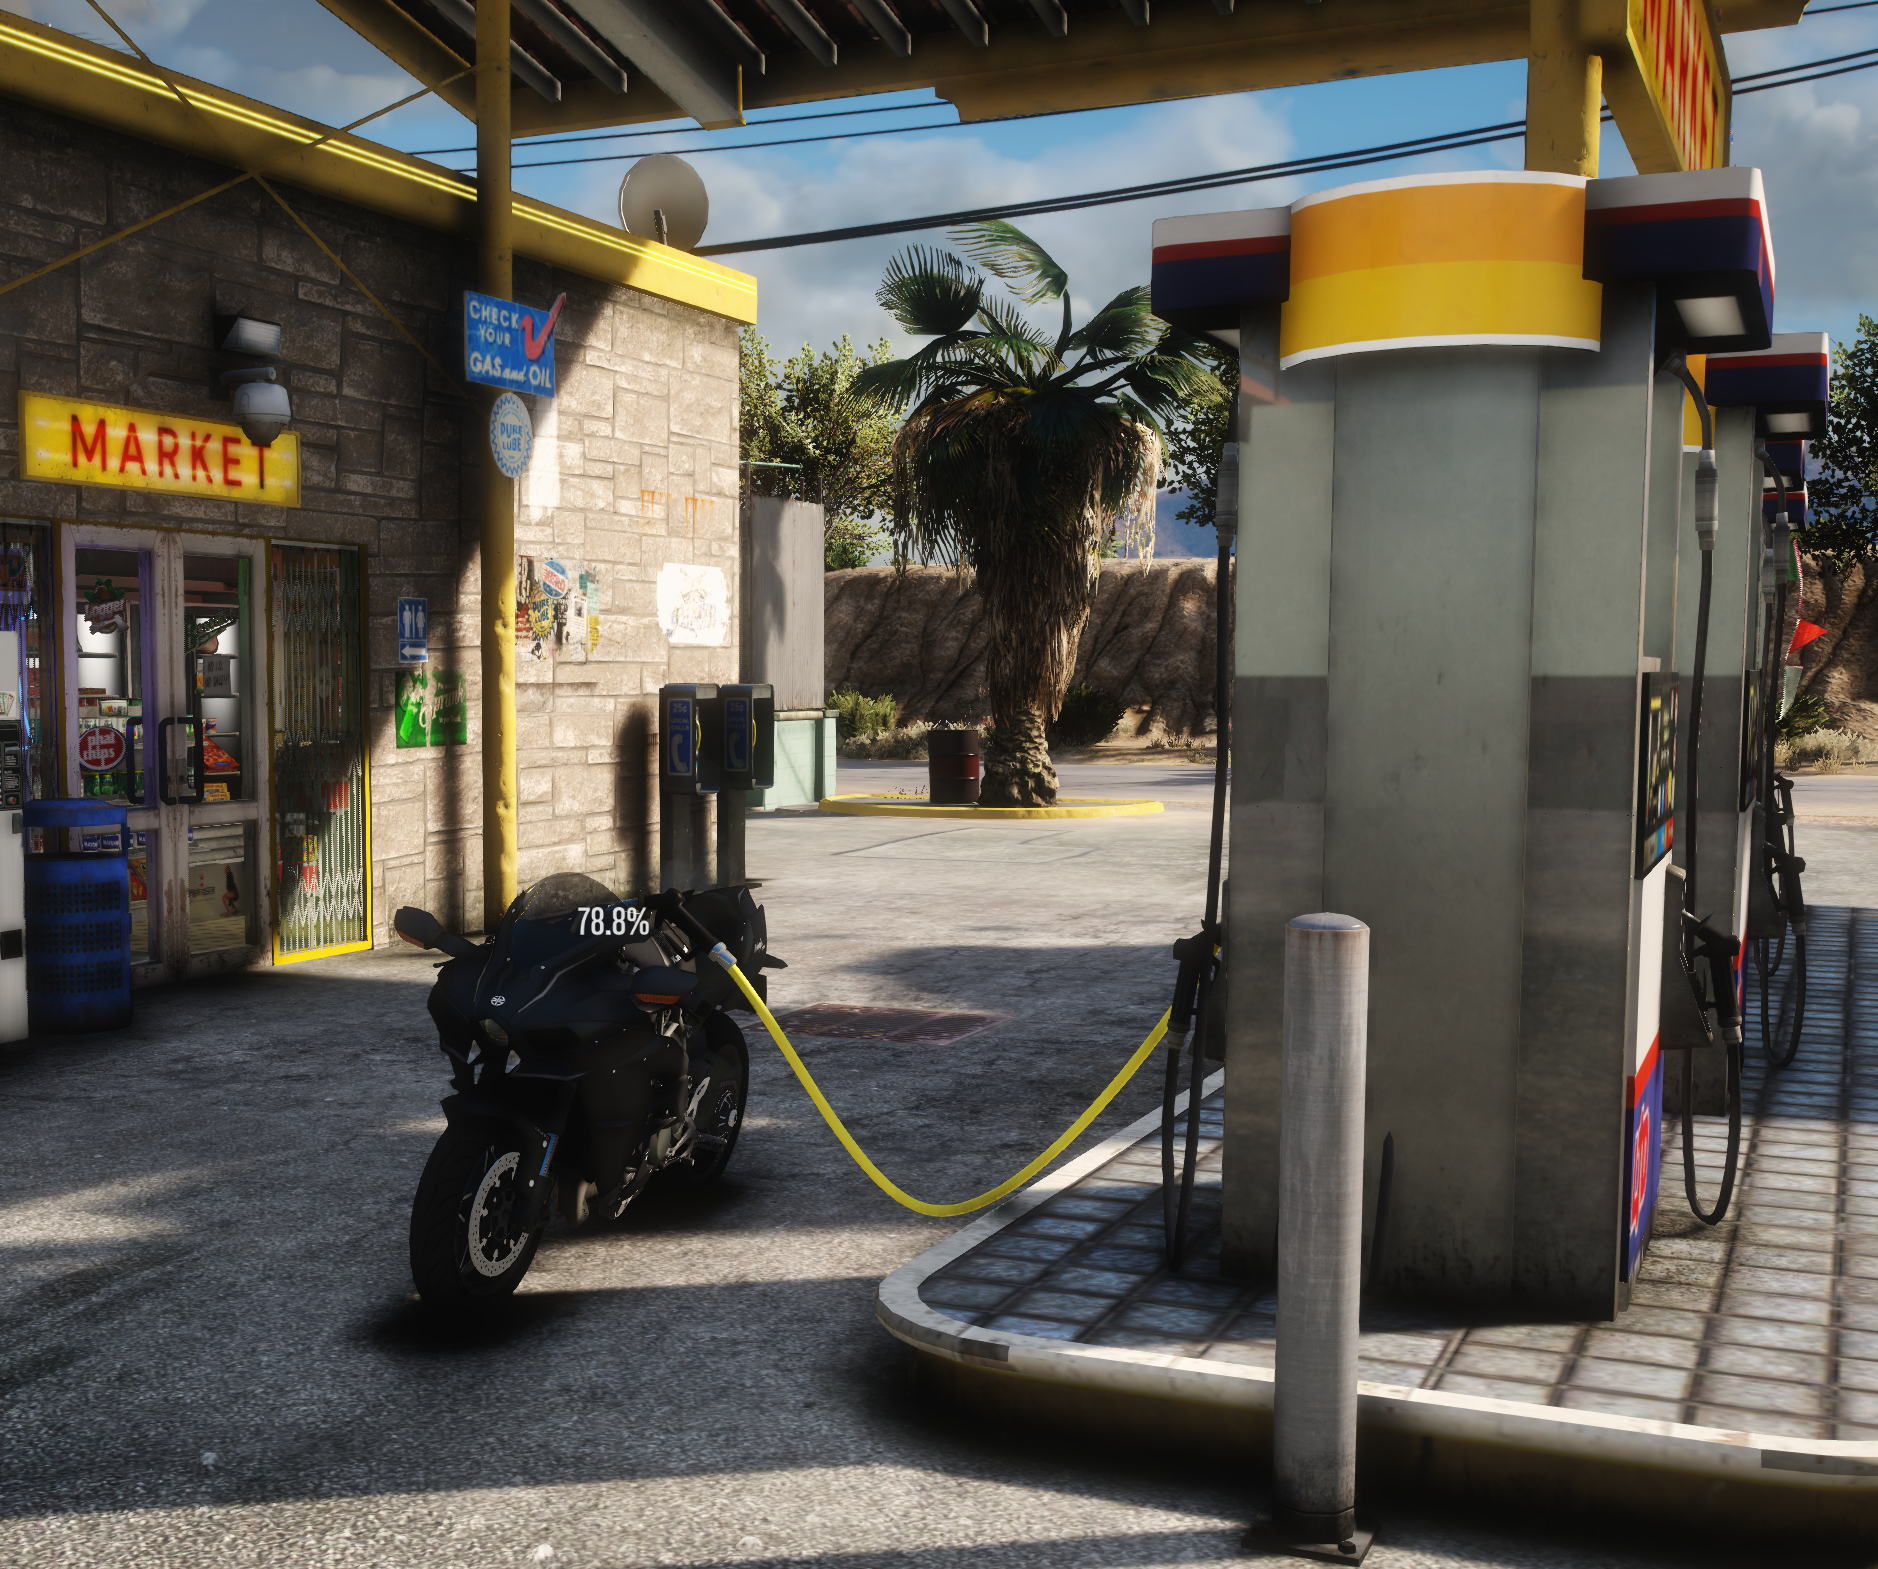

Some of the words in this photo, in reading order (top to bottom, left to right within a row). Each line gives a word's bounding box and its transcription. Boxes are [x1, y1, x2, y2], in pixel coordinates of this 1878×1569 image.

[469, 301, 519, 330] CHECK
[479, 324, 511, 347] YOUR
[470, 351, 502, 377] GAS
[502, 365, 526, 384] and
[529, 365, 552, 389] OIL
[500, 422, 523, 439] PURE
[71, 413, 271, 489] MARKET
[502, 437, 521, 452] LUBE
[532, 598, 550, 614] PURE
[534, 608, 550, 624] LUBE
[673, 703, 688, 714] 25¢
[730, 702, 744, 714] 25¢
[670, 717, 690, 725] LOCAL
